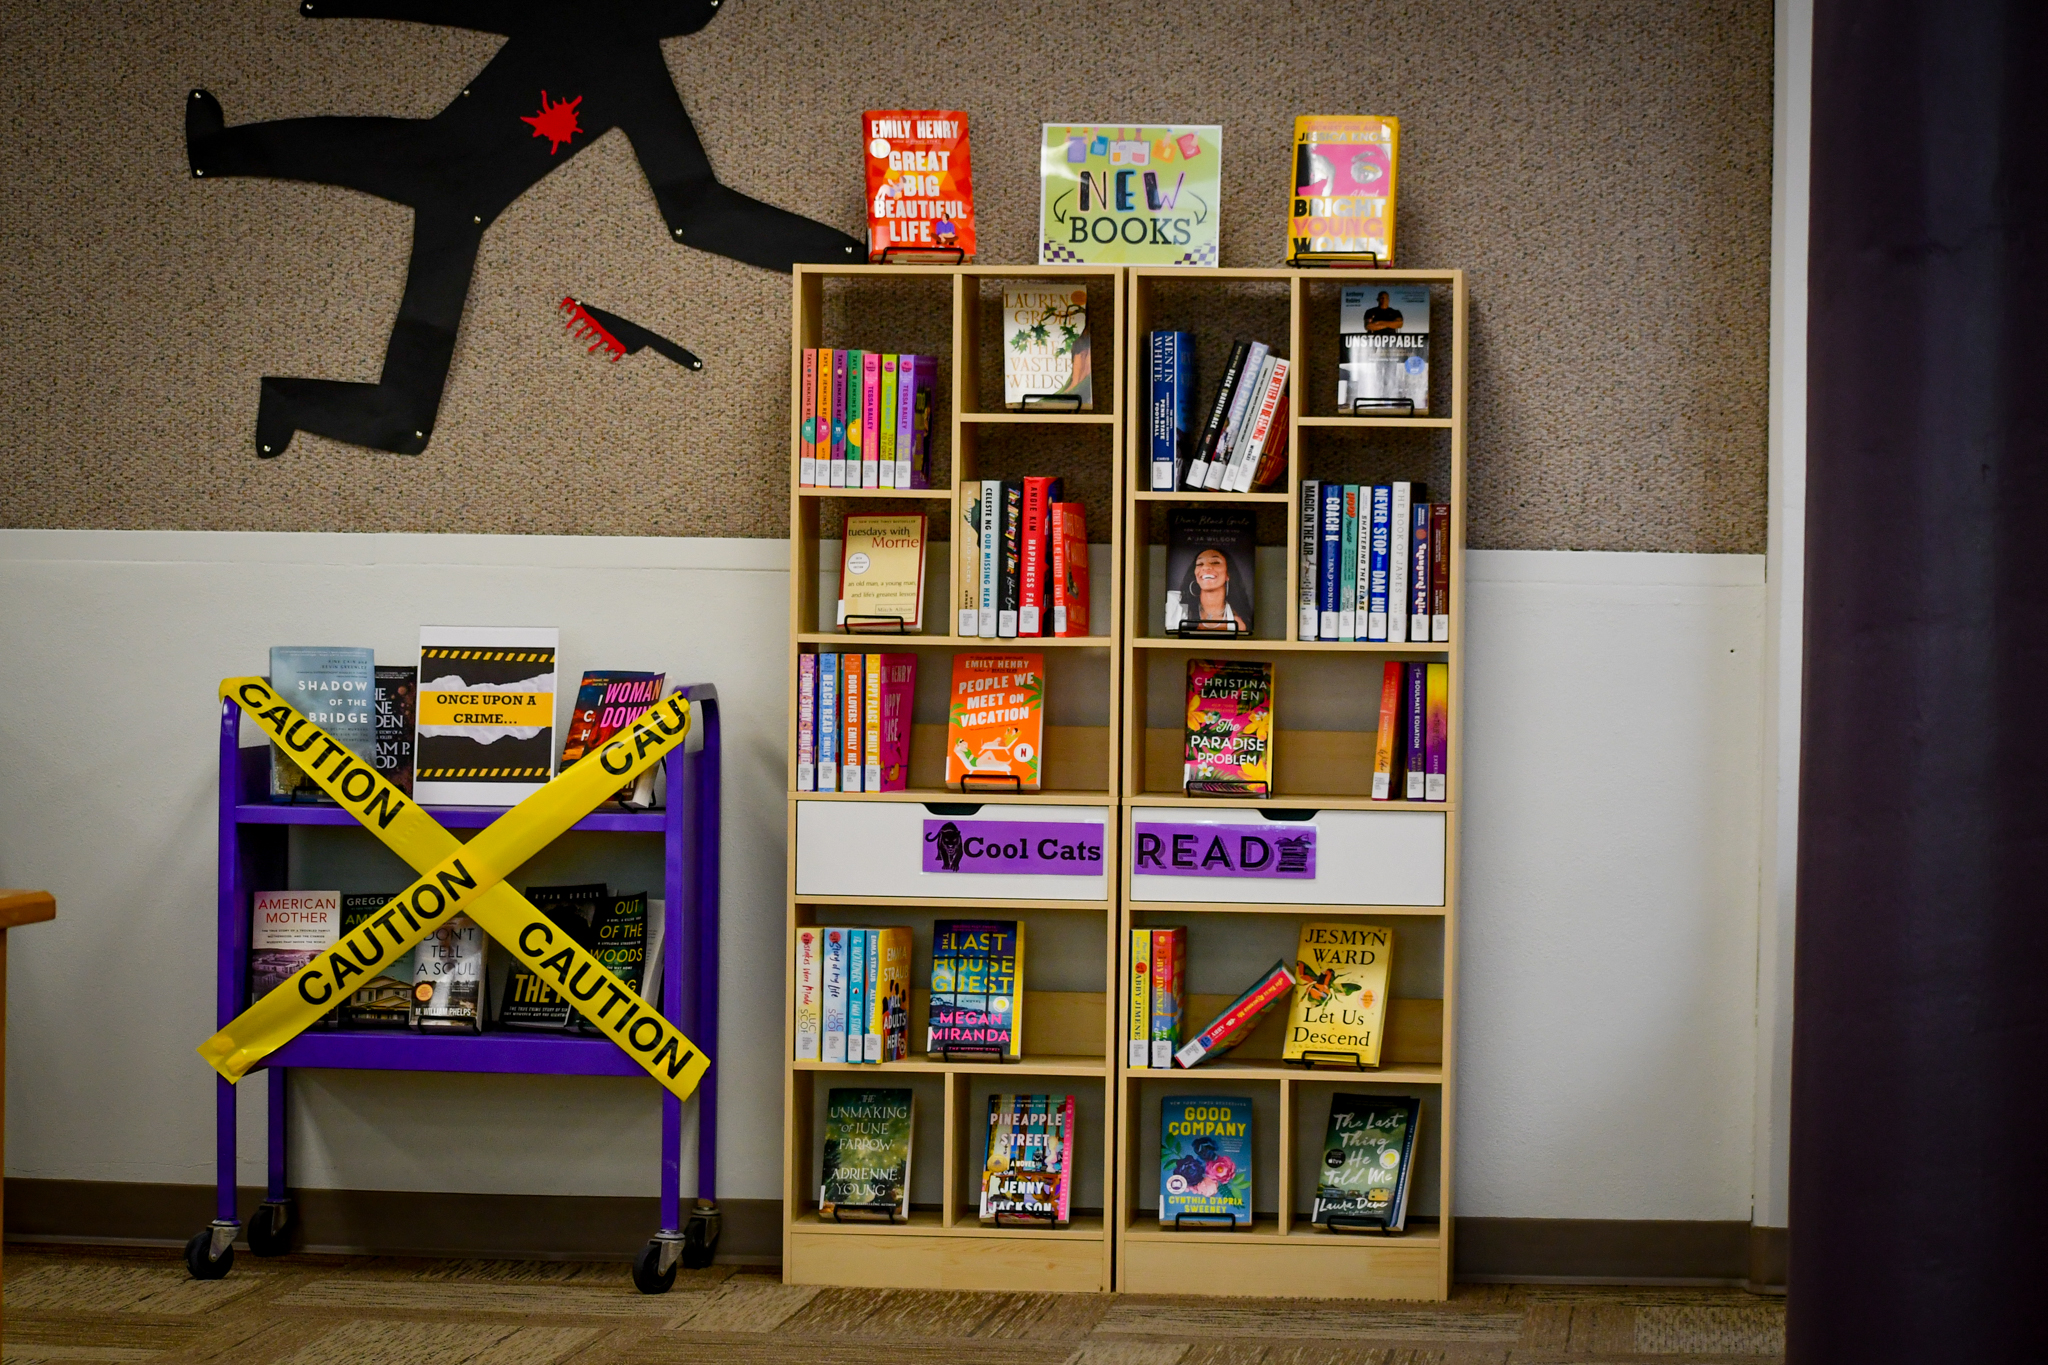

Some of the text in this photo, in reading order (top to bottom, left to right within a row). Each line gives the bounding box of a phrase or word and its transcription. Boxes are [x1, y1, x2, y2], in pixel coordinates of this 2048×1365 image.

[872, 120, 959, 138] EMILY HENRY
[889, 151, 950, 171] GREAT
[904, 175, 940, 196] BIG
[1080, 170, 1185, 211] NEW
[874, 200, 967, 219] BEAUTIFUL
[1294, 198, 1386, 217] BRIGHT
[890, 221, 931, 242] LIFE
[1069, 217, 1191, 245] BOOKS
[1293, 218, 1384, 237] YOUNG
[1293, 237, 1388, 252] WOMEN
[1005, 294, 1069, 308] LAUREN
[1028, 340, 1058, 355] THE
[1345, 335, 1424, 348] UNSTOPPABLE
[1010, 357, 1073, 372] VASTER
[1154, 337, 1162, 382] WHITE
[1165, 335, 1173, 383] MEN IN
[1006, 374, 1063, 389] WILDS
[1224, 369, 1235, 388] BLACK
[1346, 492, 1356, 518] HOOP
[985, 520, 991, 530] NG
[1303, 485, 1315, 555] MAGIC IN THE AIR
[1325, 497, 1339, 542] COACH K
[848, 527, 910, 538] tuesdays with
[872, 536, 919, 548] Morrie
[1372, 489, 1388, 592] NEVER STOP DAN
[1396, 544, 1403, 556] OF
[1026, 539, 1036, 588] HAPPINESS
[1395, 560, 1403, 593] JAMES
[298, 680, 368, 691] SHADOW
[823, 674, 833, 706] BEACH
[959, 672, 1034, 694] PEOPLE WE
[1194, 677, 1267, 689] CHRISTINA
[604, 679, 663, 704] WOMAN
[1201, 689, 1260, 700] LAUREN
[329, 699, 367, 707] OF THE
[437, 694, 536, 706] ONCE UPON A
[967, 693, 1024, 710] MEET ON
[309, 713, 368, 724] BRIDGE
[453, 713, 517, 724] CRIME...
[802, 673, 812, 750] FUNNY STORY EMILY
[848, 675, 857, 750] BOOK LOVERS EMILY
[867, 673, 878, 753] HAPPY PLACE EMILY
[961, 707, 1029, 727] VACATION
[822, 709, 832, 733] READ
[1216, 719, 1240, 732] The
[1191, 736, 1265, 751] PARADISE
[238, 683, 405, 830] CAUTION
[1198, 753, 1257, 765] PROBLEM
[963, 837, 1101, 861] Cool Cats
[1137, 833, 1273, 871] READ
[258, 899, 336, 910] AMERICAN
[347, 897, 384, 906] GREGG
[615, 899, 639, 914] OUT
[266, 912, 327, 923] MOTHER
[298, 859, 478, 1006] CAUTION
[600, 923, 643, 938] OF THE
[1305, 929, 1387, 946] JESMYN
[950, 933, 1007, 951] LAST
[431, 945, 463, 958] TELL
[590, 948, 643, 962] WOODS
[1313, 948, 1375, 965] WARD
[416, 962, 475, 975] A SOUL
[934, 954, 1014, 973] HOUSE
[932, 976, 1013, 994] GUEST
[519, 922, 694, 1080] CAUTION
[891, 996, 900, 1008] ALL
[449, 1008, 471, 1016] PHELPS
[940, 1012, 1002, 1025] MEGAN
[1304, 1007, 1364, 1025] Let Us
[884, 1013, 906, 1030] ADULTS
[931, 1028, 1009, 1042] MIRANDA
[1292, 1027, 1371, 1047] Descend
[831, 1107, 907, 1119] UNMAKING
[990, 1113, 1062, 1126] PINEAPPLE
[1185, 1107, 1231, 1121] GOOD
[855, 1123, 889, 1134] JUNE
[1333, 1112, 1403, 1130] The Last
[1169, 1122, 1246, 1137] COMPANY
[839, 1138, 893, 1151] FARROW
[1000, 1133, 1050, 1147] STREET
[1340, 1130, 1389, 1154] Thing
[831, 1168, 898, 1180] ADRIENNE
[1324, 1167, 1393, 1185] Told Me
[836, 1183, 885, 1196] YOUNG
[1000, 1181, 1044, 1194] JENNY
[988, 1202, 1052, 1214] JACKSON
[1169, 1196, 1243, 1205] CYNTHIA D'APRIX
[1319, 1197, 1355, 1212] Laura
[1184, 1206, 1226, 1214] SWEENEY
